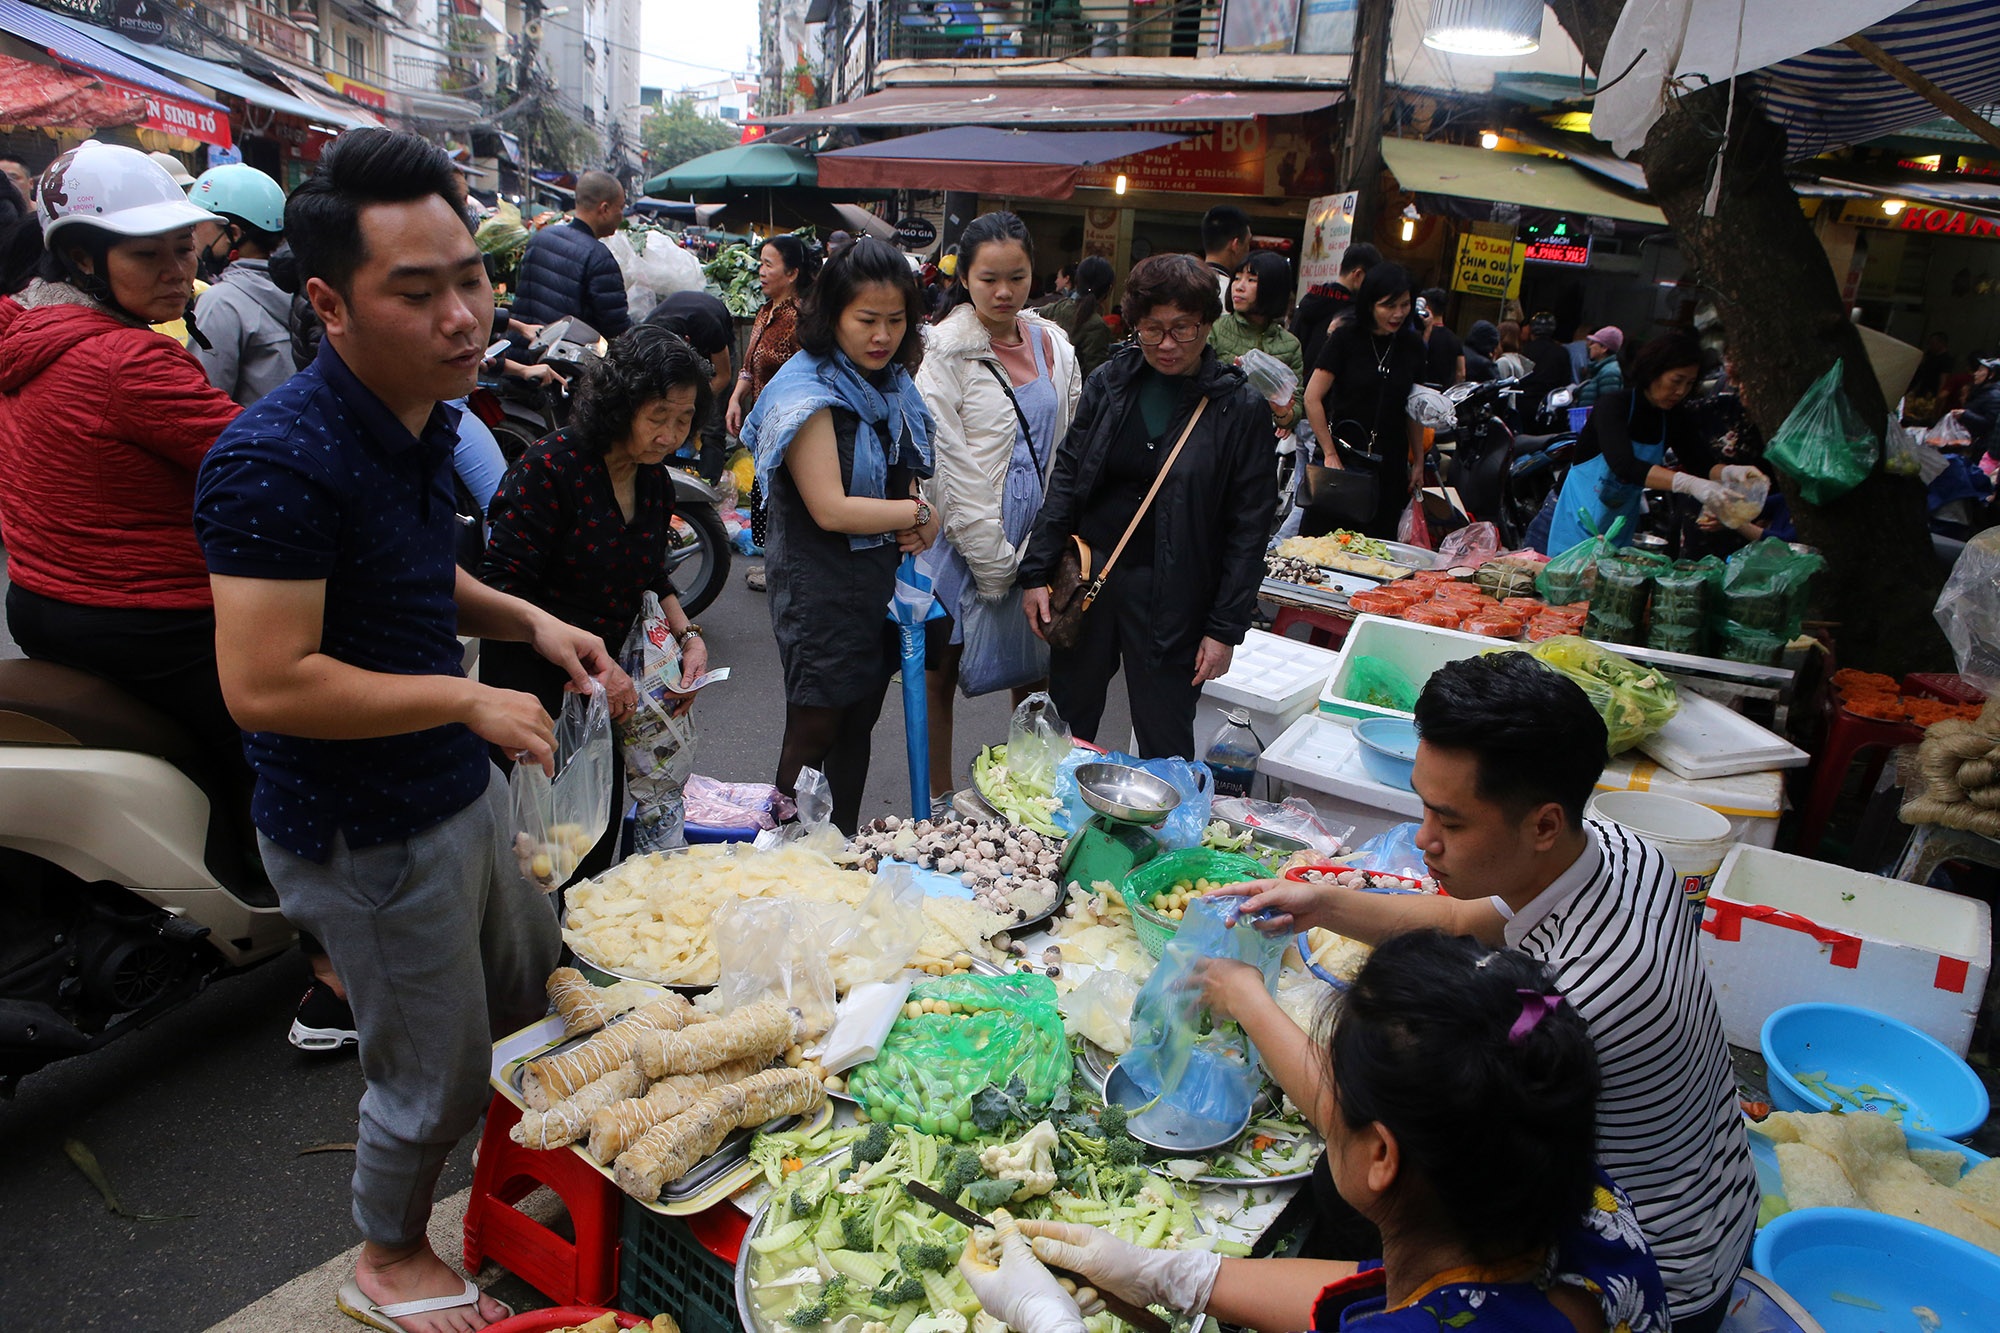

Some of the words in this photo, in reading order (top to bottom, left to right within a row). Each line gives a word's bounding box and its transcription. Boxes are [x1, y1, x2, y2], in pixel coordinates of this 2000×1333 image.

[163, 104, 198, 129] SINH
[1143, 165, 1173, 177] beef
[1176, 168, 1190, 178] or
[77, 195, 95, 203] CONY
[73, 203, 96, 212] BROWN
[918, 230, 934, 238] GIA
[1460, 255, 1487, 269] CHIM
[1482, 273, 1512, 288] QUAY
